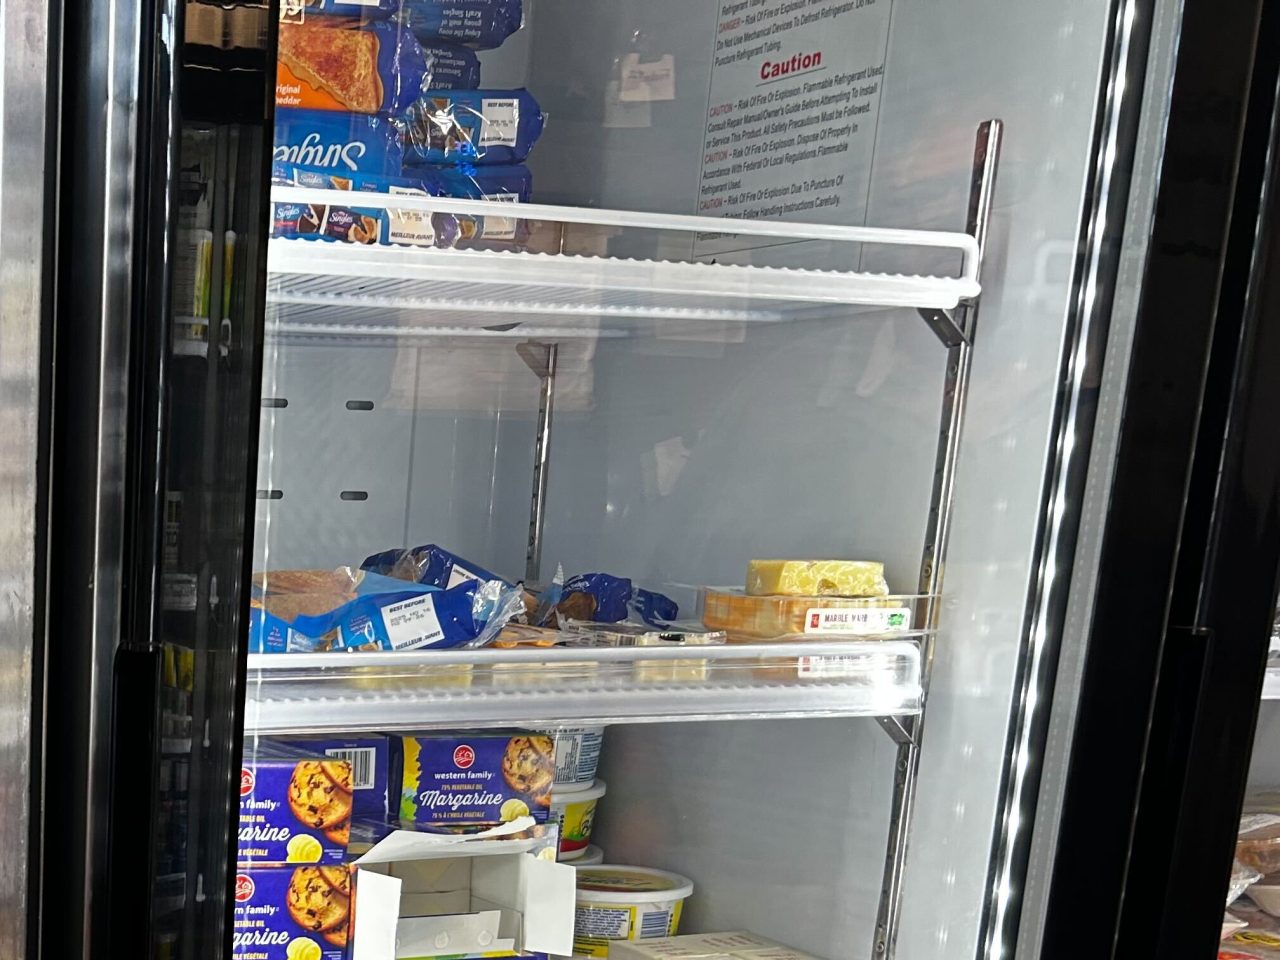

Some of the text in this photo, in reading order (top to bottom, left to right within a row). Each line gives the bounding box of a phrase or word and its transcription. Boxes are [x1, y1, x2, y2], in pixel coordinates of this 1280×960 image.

[760, 51, 822, 80] Caution
[277, 206, 300, 219] Singles
[329, 212, 353, 224] Singles
[390, 231, 434, 241] MEILLEUR AVANT
[389, 598, 426, 613] BEST BEFORE
[395, 637, 422, 650] MEILLEUR
[434, 770, 492, 781] western family
[246, 799, 276, 811] family
[419, 790, 503, 810] Margarine
[246, 904, 276, 916] family
[232, 928, 290, 950] garine
